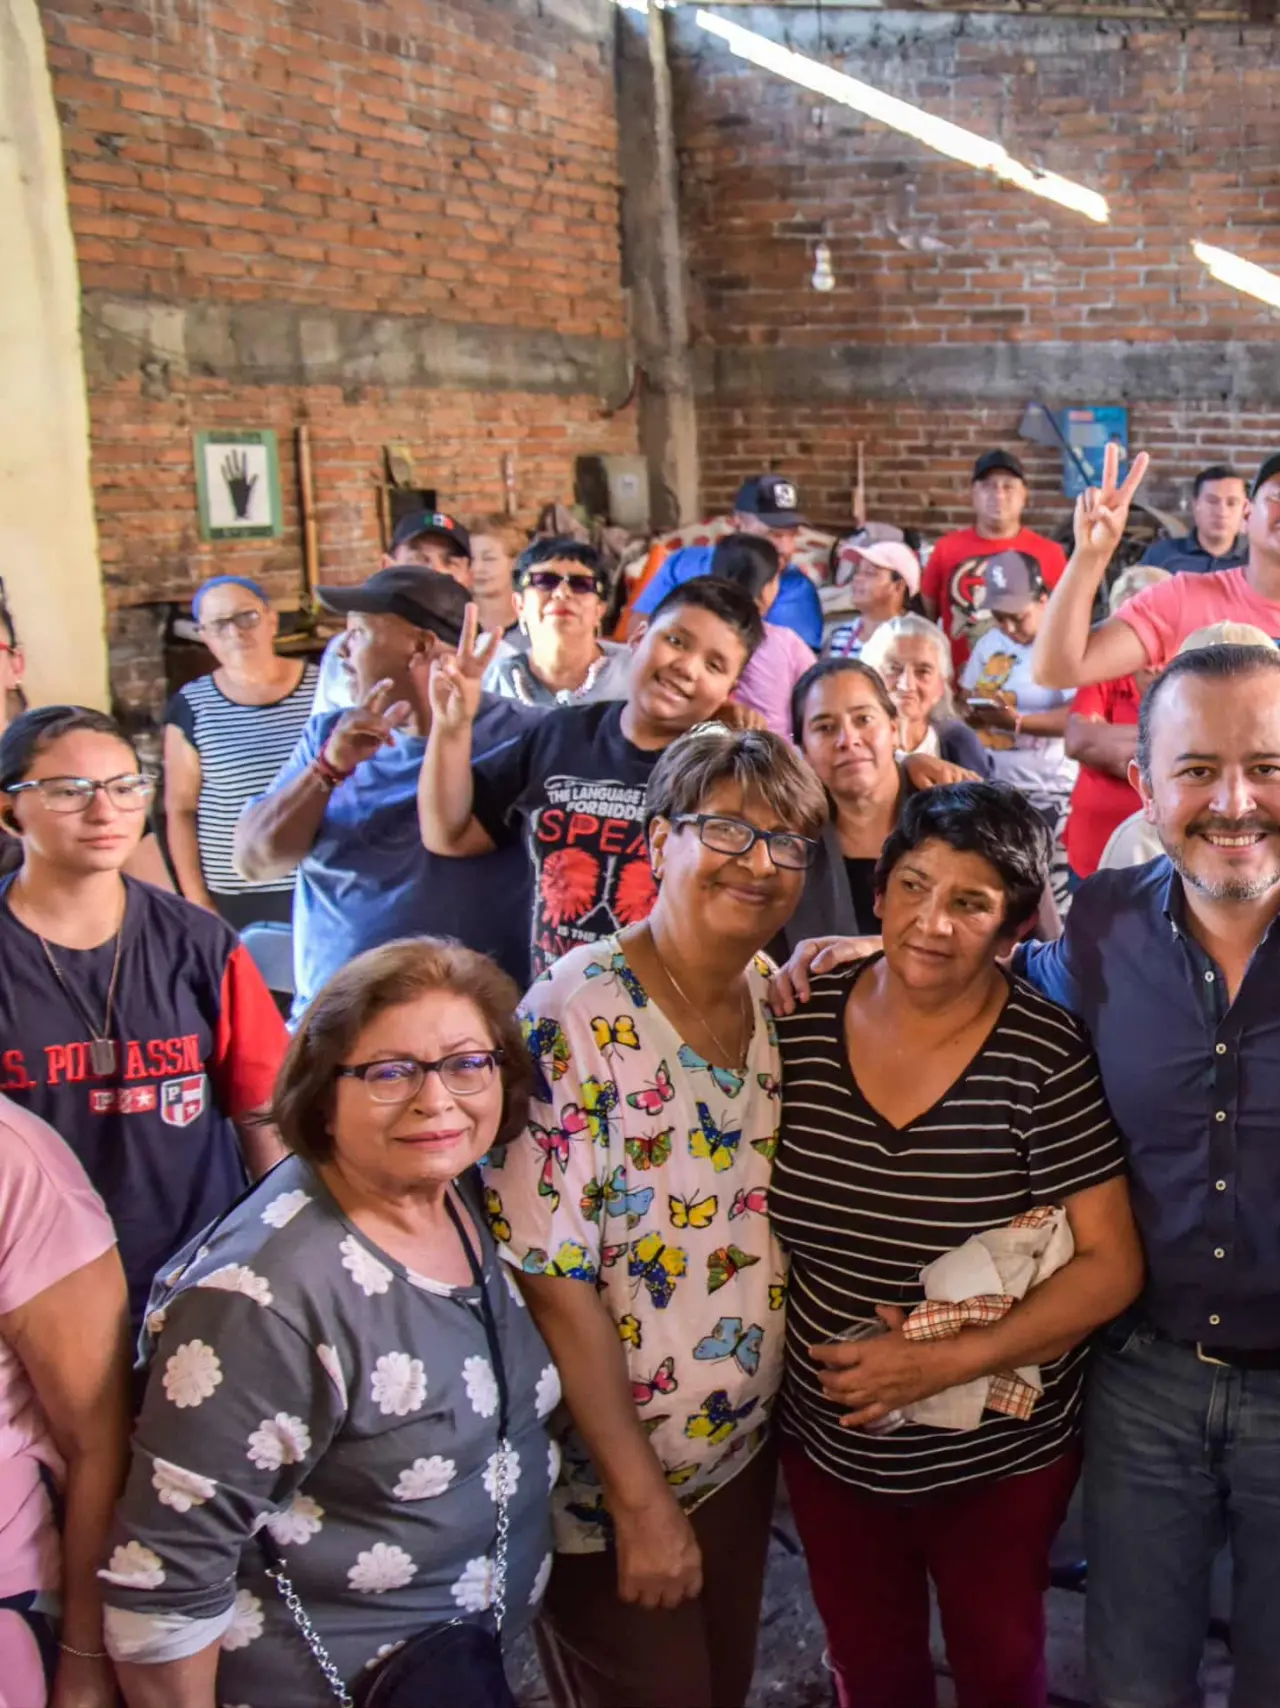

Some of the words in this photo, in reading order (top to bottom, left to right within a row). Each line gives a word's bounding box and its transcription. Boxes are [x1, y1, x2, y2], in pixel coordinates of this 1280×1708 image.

[547, 789, 571, 804] THE
[573, 786, 641, 805] LANGUAGE
[566, 800, 646, 822] FORBIDDE
[537, 808, 648, 856] SPEA
[44, 1042, 114, 1085] PO
